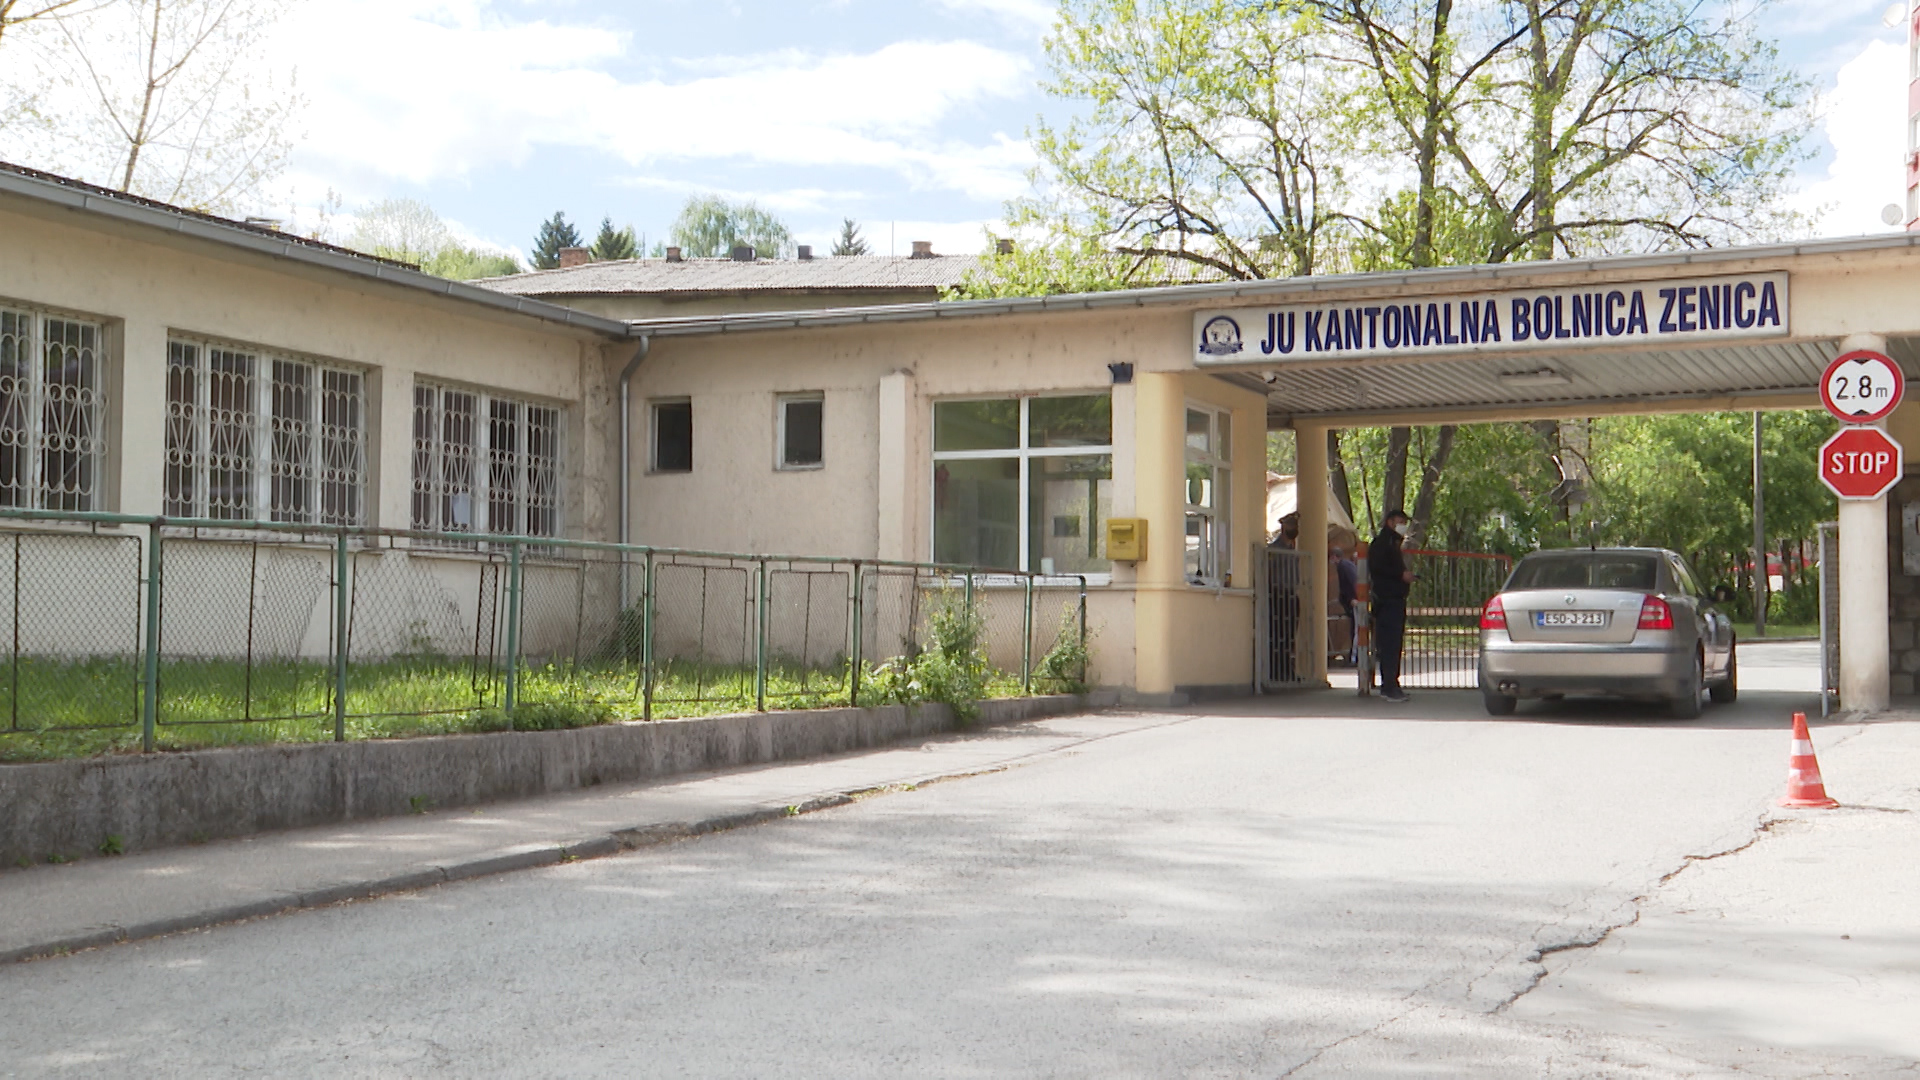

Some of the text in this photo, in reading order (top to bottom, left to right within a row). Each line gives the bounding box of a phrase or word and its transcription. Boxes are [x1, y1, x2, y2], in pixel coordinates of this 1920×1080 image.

[1261, 281, 1781, 355] JU KANTONALNA BOLNICA ZENICA
[1835, 375, 1888, 400] 2.8 m
[1831, 452, 1890, 475] STOP
